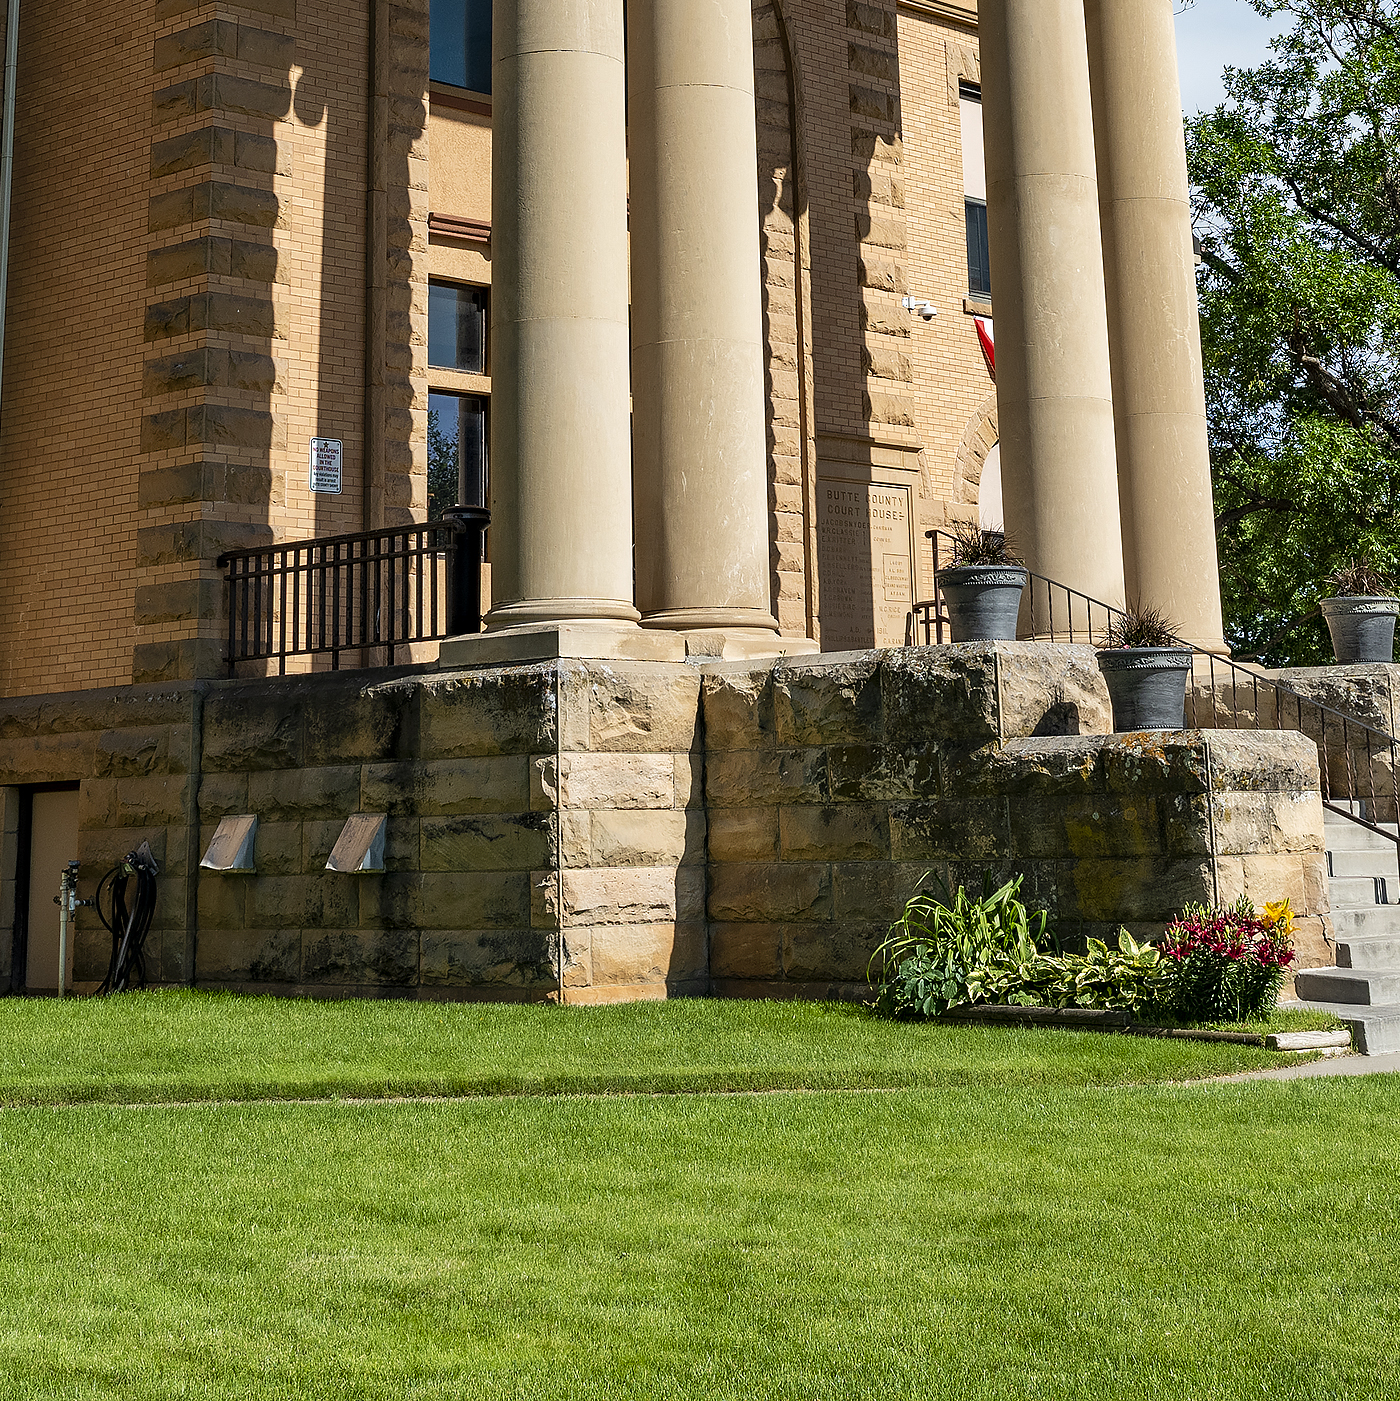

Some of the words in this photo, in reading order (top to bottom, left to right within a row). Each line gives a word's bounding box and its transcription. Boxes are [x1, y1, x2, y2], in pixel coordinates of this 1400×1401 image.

[826, 490, 860, 502] BUTTE
[866, 494, 904, 507] COUNTY
[828, 504, 860, 516] COURT
[866, 508, 898, 520] HOUSE
